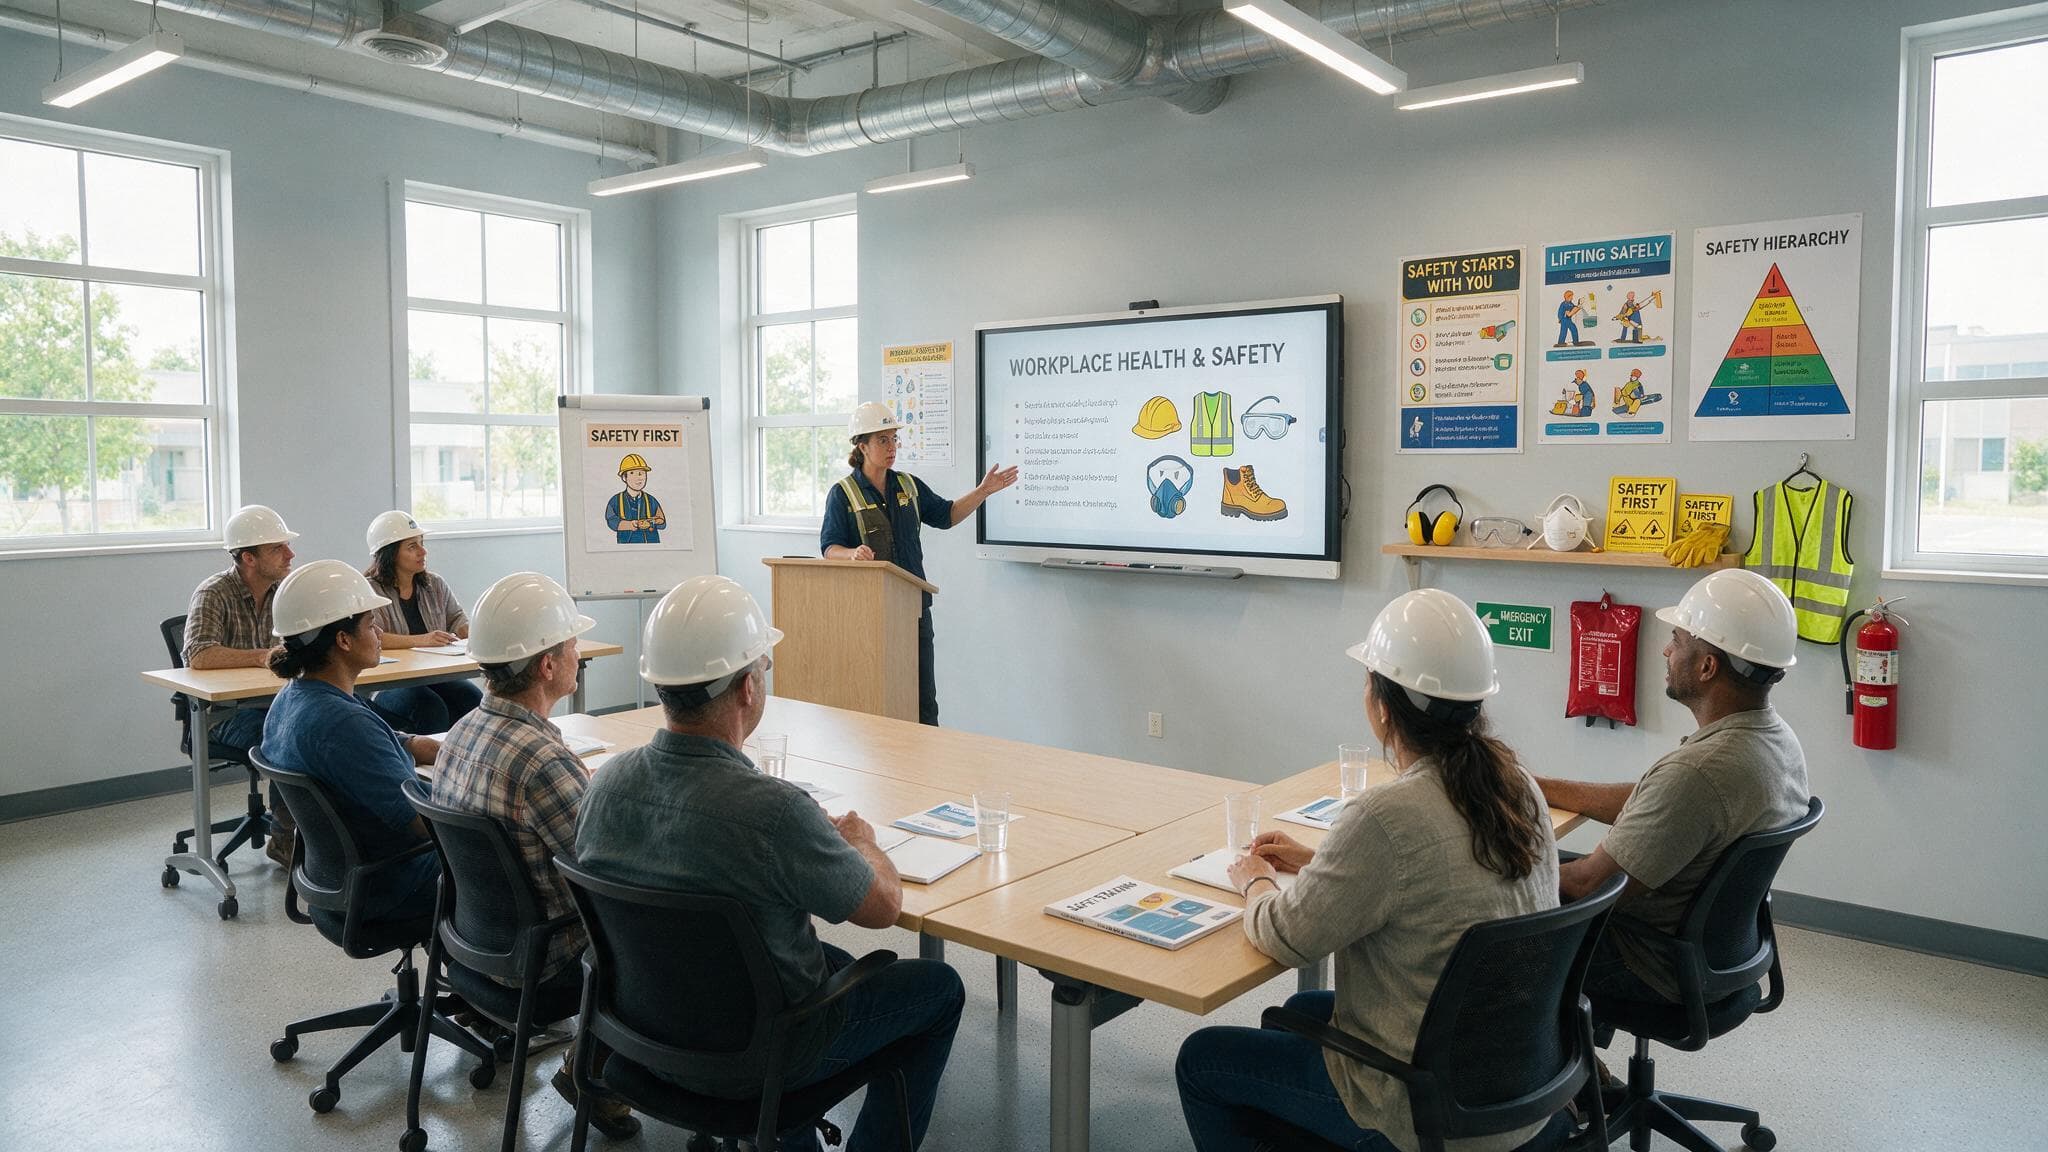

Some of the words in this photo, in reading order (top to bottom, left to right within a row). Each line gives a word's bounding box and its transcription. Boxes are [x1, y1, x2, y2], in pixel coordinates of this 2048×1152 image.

[1706, 238, 1759, 255] SAFETY
[1764, 229, 1850, 251] HIERARCHY
[1551, 247, 1605, 267] LIFTING
[1610, 241, 1664, 260] SAFELY
[1407, 260, 1458, 279] SAFETY
[1462, 255, 1515, 273] STARTS
[1427, 276, 1462, 293] WITH
[1466, 275, 1493, 291] YOU
[1009, 353, 1113, 377] WORKPLACE
[1117, 348, 1186, 371] HEALTH
[1192, 347, 1206, 367] &
[1211, 342, 1285, 366] SAFETY
[591, 430, 638, 442] SAFETY
[643, 430, 679, 442] FIRST
[1617, 483, 1667, 496] SAFETY
[1621, 498, 1658, 509] FIRST
[1685, 500, 1724, 511] SAFETY
[1509, 627, 1534, 642] EXIT
